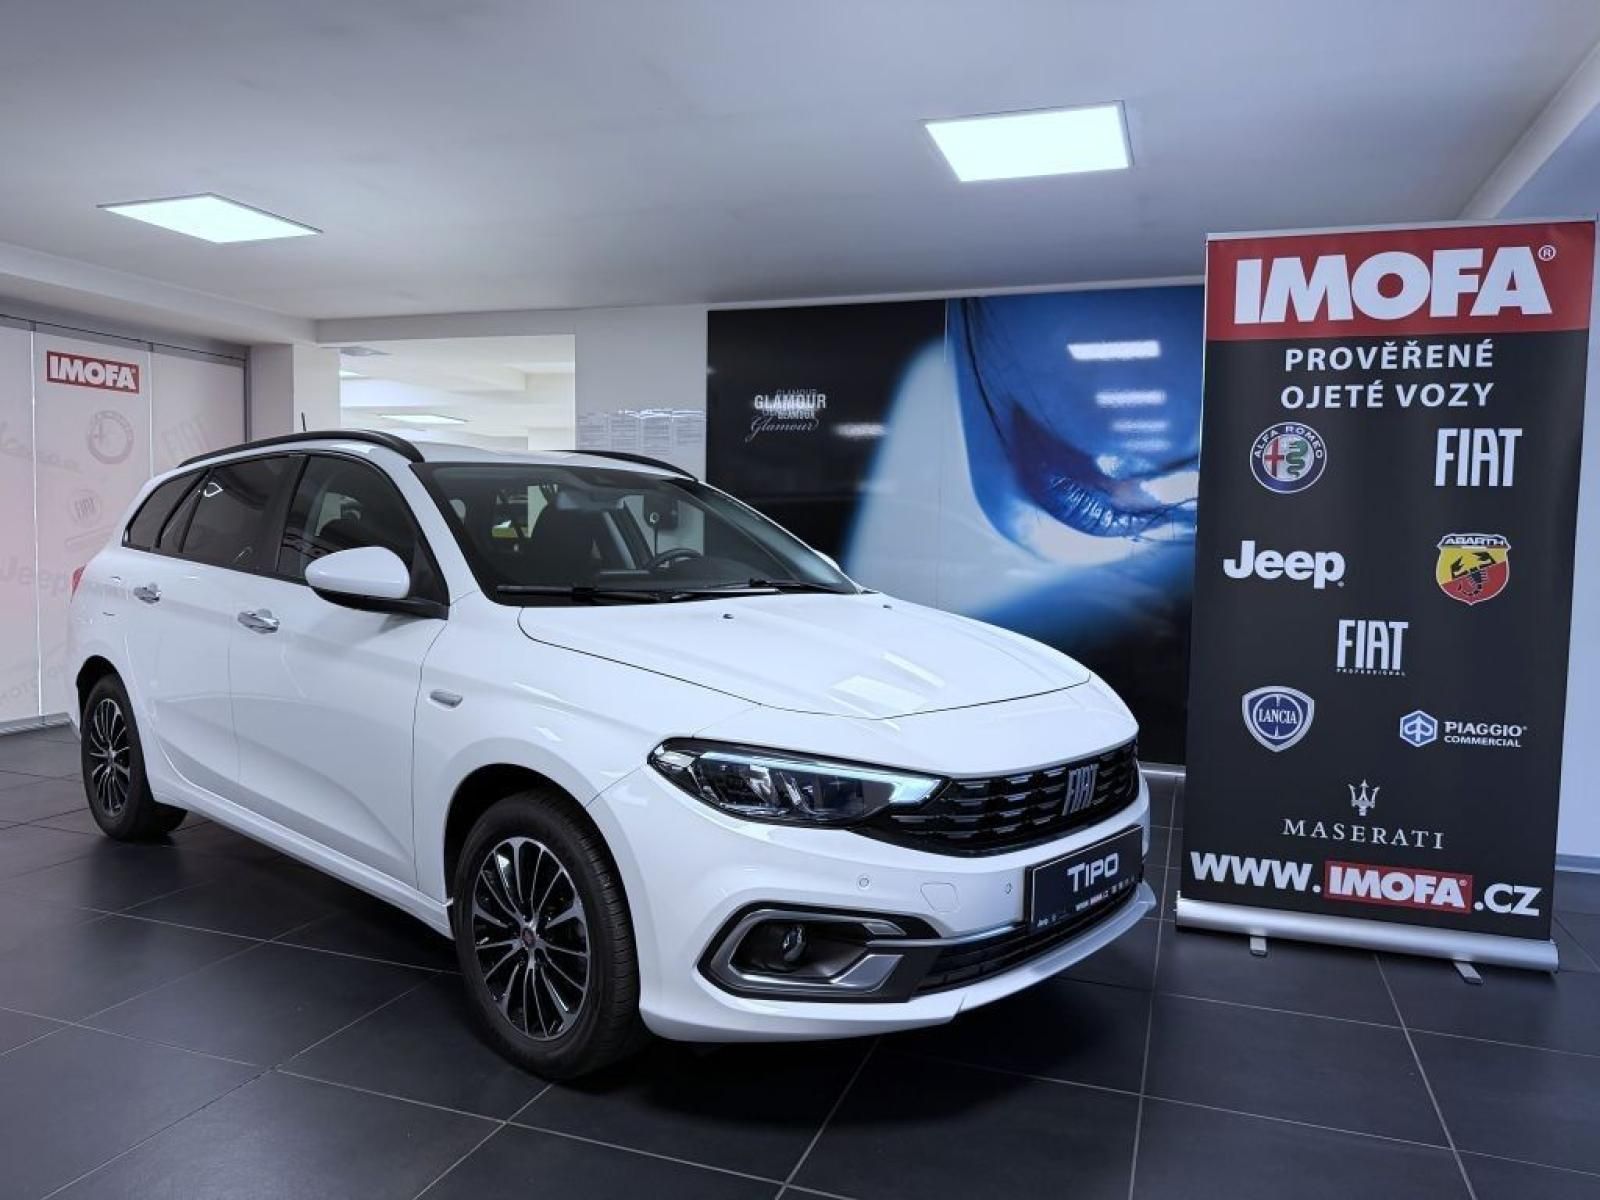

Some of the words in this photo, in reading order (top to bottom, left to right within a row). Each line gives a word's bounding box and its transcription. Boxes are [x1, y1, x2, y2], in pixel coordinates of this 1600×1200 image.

[1284, 338, 1494, 372] PROVĚŘENÉ
[754, 393, 827, 410] GLAMOUR
[1280, 380, 1384, 410] OJETÉ
[1395, 382, 1495, 408] VOZY
[1254, 429, 1279, 459] ALFA
[1285, 425, 1323, 459] ROMEO
[1435, 427, 1523, 488] FIAT
[1223, 540, 1345, 589] Jeep
[1337, 619, 1409, 670] FIAT
[1258, 708, 1298, 725] LANCIA
[1444, 735, 1521, 748] COMMERCIAL
[1062, 763, 1100, 817] FIAT
[1282, 818, 1446, 850] MASERATI
[1067, 853, 1118, 891] TIPO
